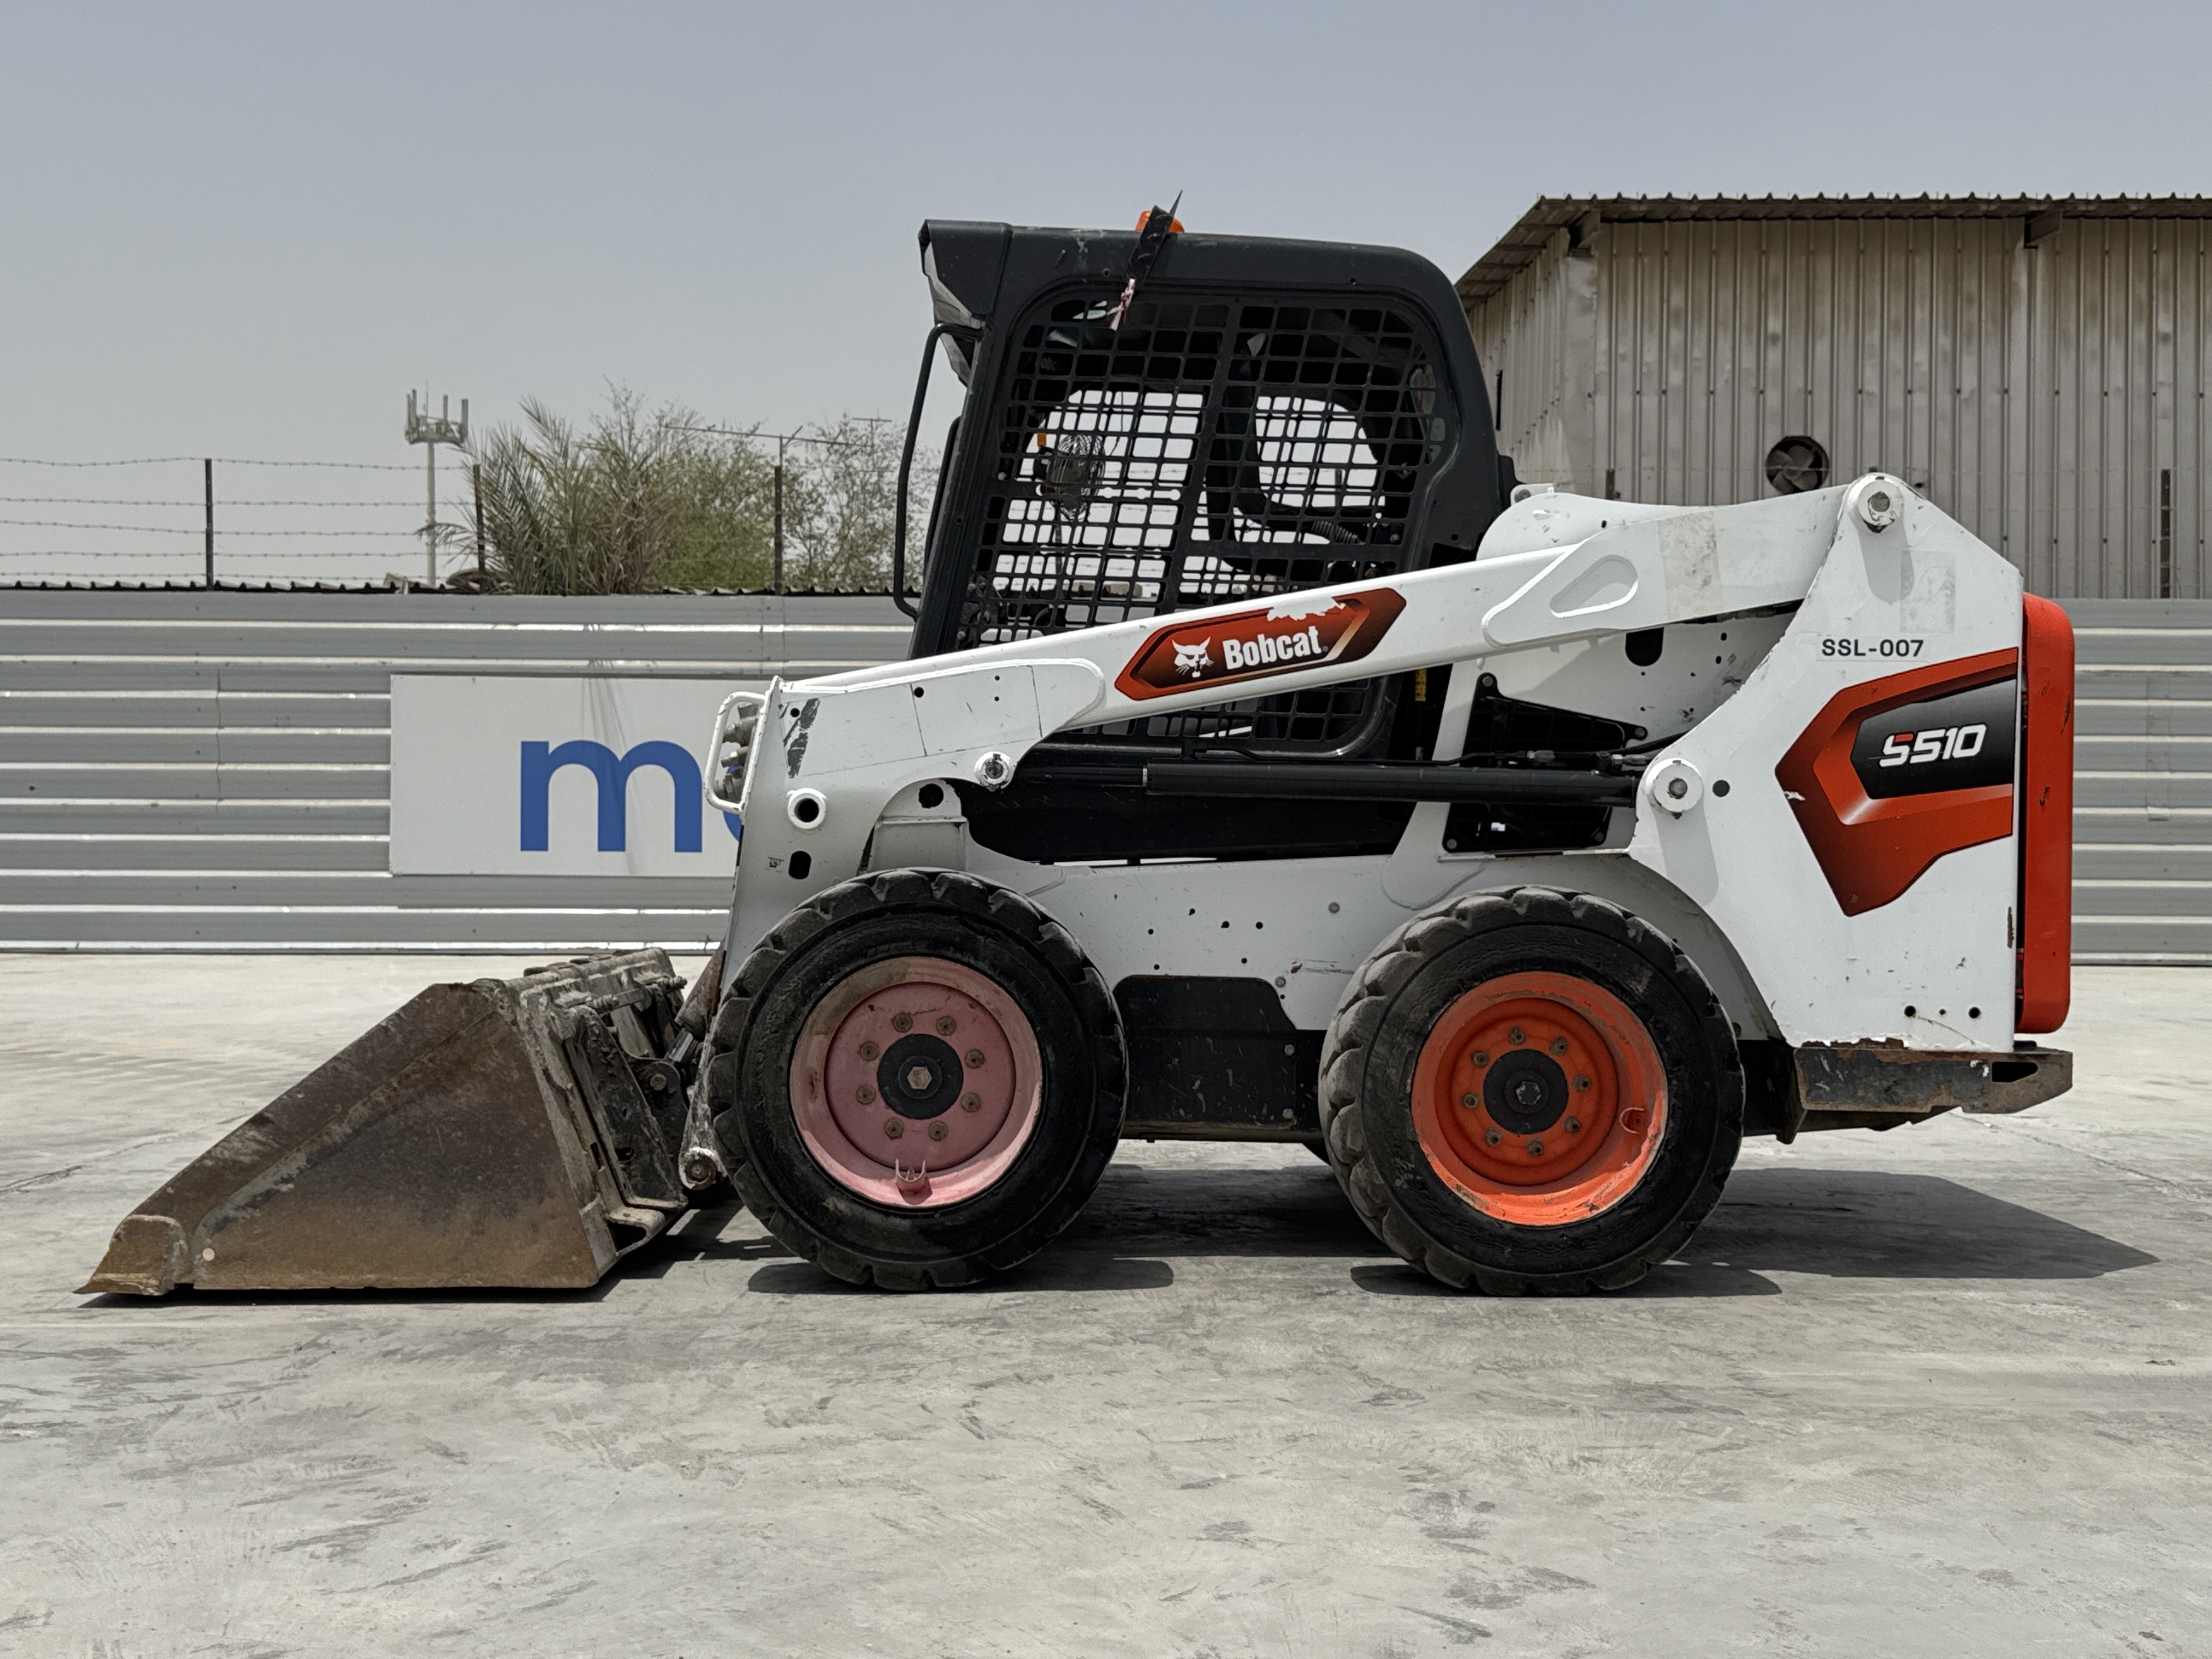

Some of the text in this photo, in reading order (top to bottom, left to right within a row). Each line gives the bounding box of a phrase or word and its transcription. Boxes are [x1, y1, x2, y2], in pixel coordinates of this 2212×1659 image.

[1222, 625, 1322, 670] Bobcat
[1821, 639, 1924, 657] SSL-007
[1878, 724, 1987, 768] S510
[520, 740, 742, 853] m
